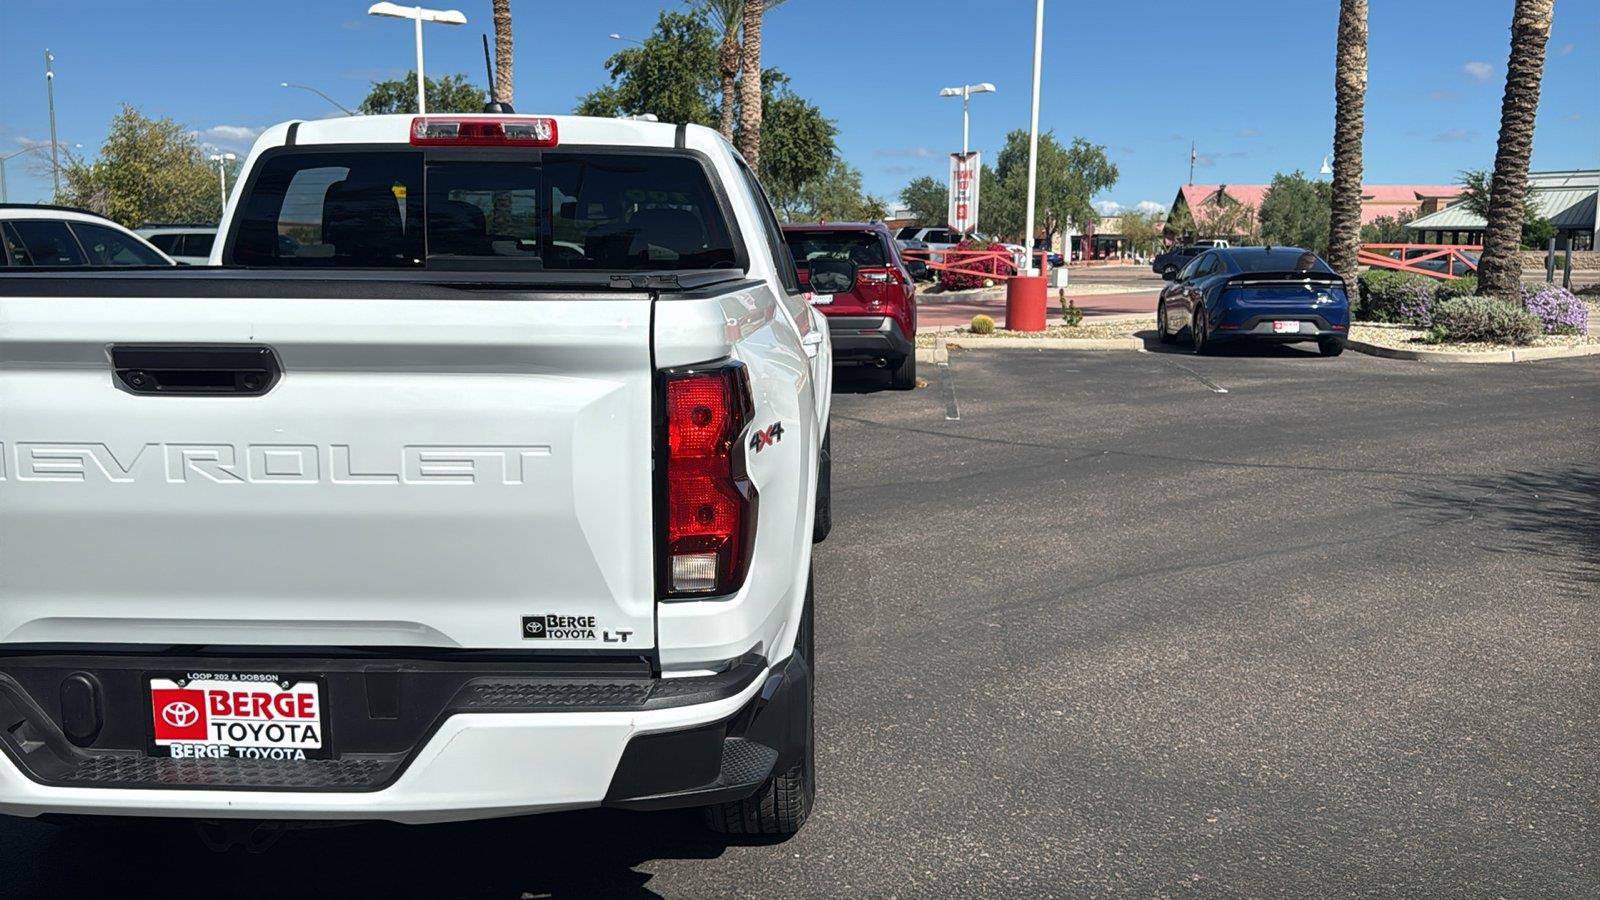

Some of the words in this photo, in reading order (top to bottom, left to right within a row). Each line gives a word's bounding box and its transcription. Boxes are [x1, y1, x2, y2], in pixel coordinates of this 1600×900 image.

[0, 441, 552, 485] EVROLET
[546, 615, 596, 628] BERGE
[547, 629, 596, 639] TOYOTA
[603, 631, 633, 642] LT
[187, 672, 212, 681] LOOP
[214, 673, 230, 682] 202
[232, 673, 238, 682] &
[240, 673, 279, 682] DOBSON
[208, 690, 316, 720] BERGE
[211, 722, 320, 743] TOYOTA
[170, 743, 230, 759] BERGE
[235, 747, 306, 760] TOYOTA
